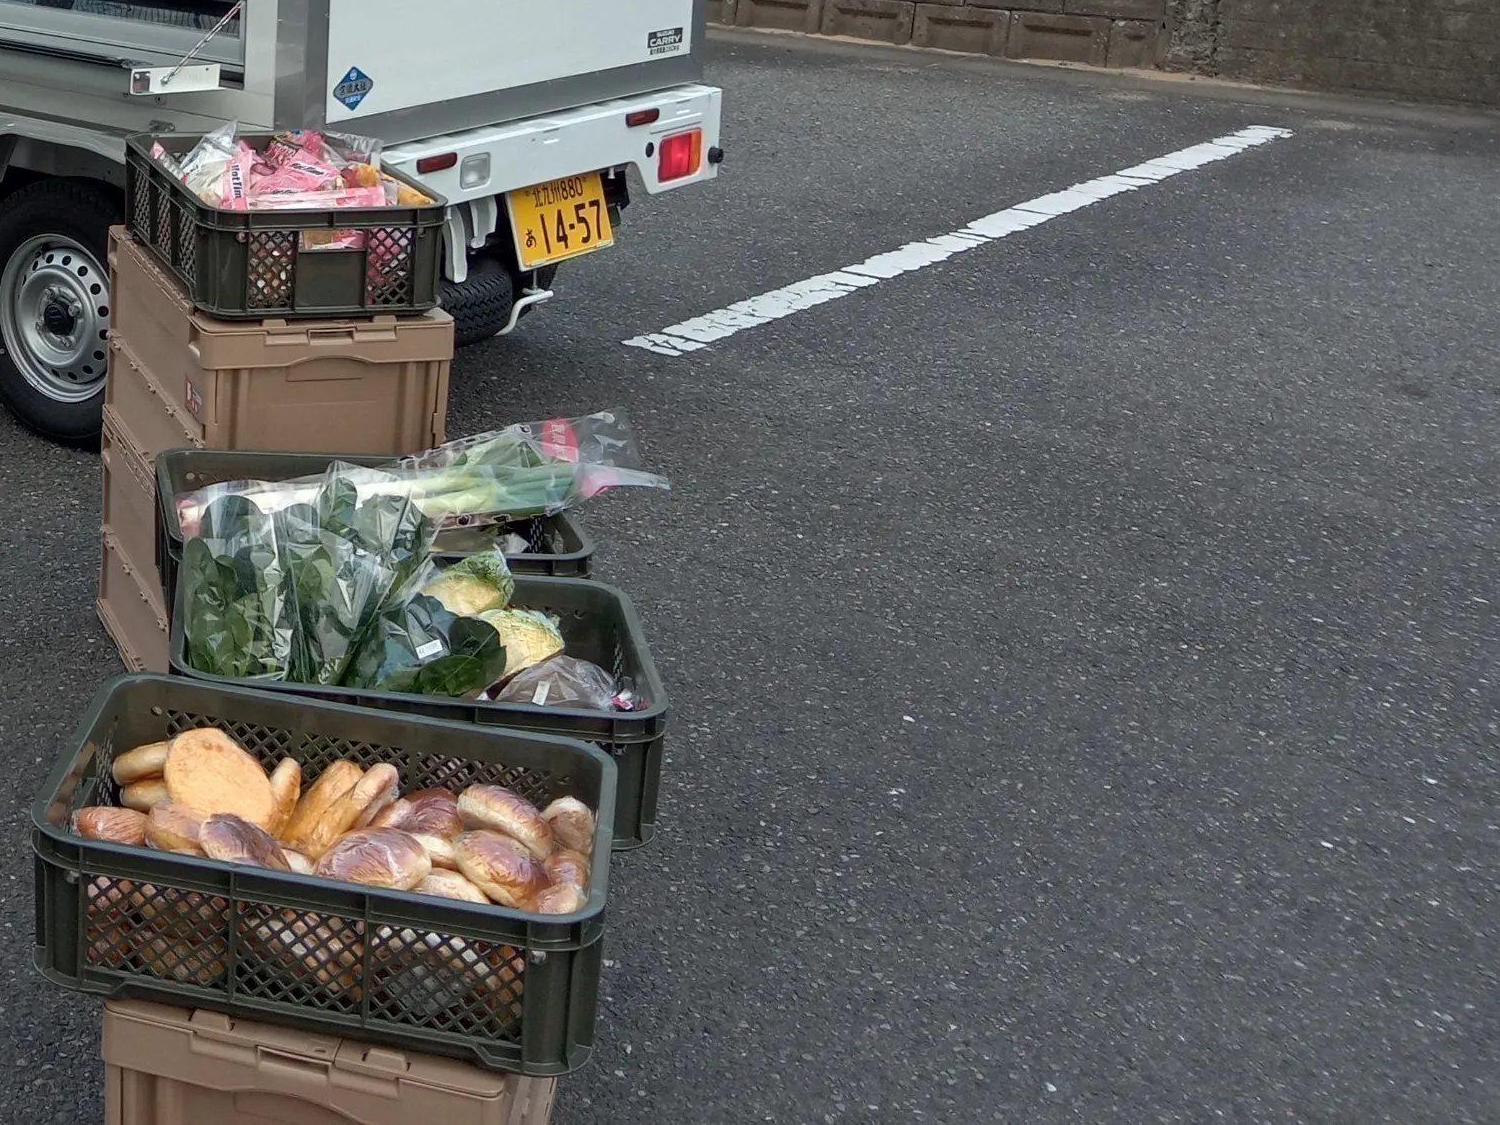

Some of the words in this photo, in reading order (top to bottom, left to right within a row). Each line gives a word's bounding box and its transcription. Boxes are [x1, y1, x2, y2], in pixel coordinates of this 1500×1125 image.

[650, 34, 681, 46] CARRY
[525, 228, 537, 249] あ
[540, 198, 602, 254] 14-57
